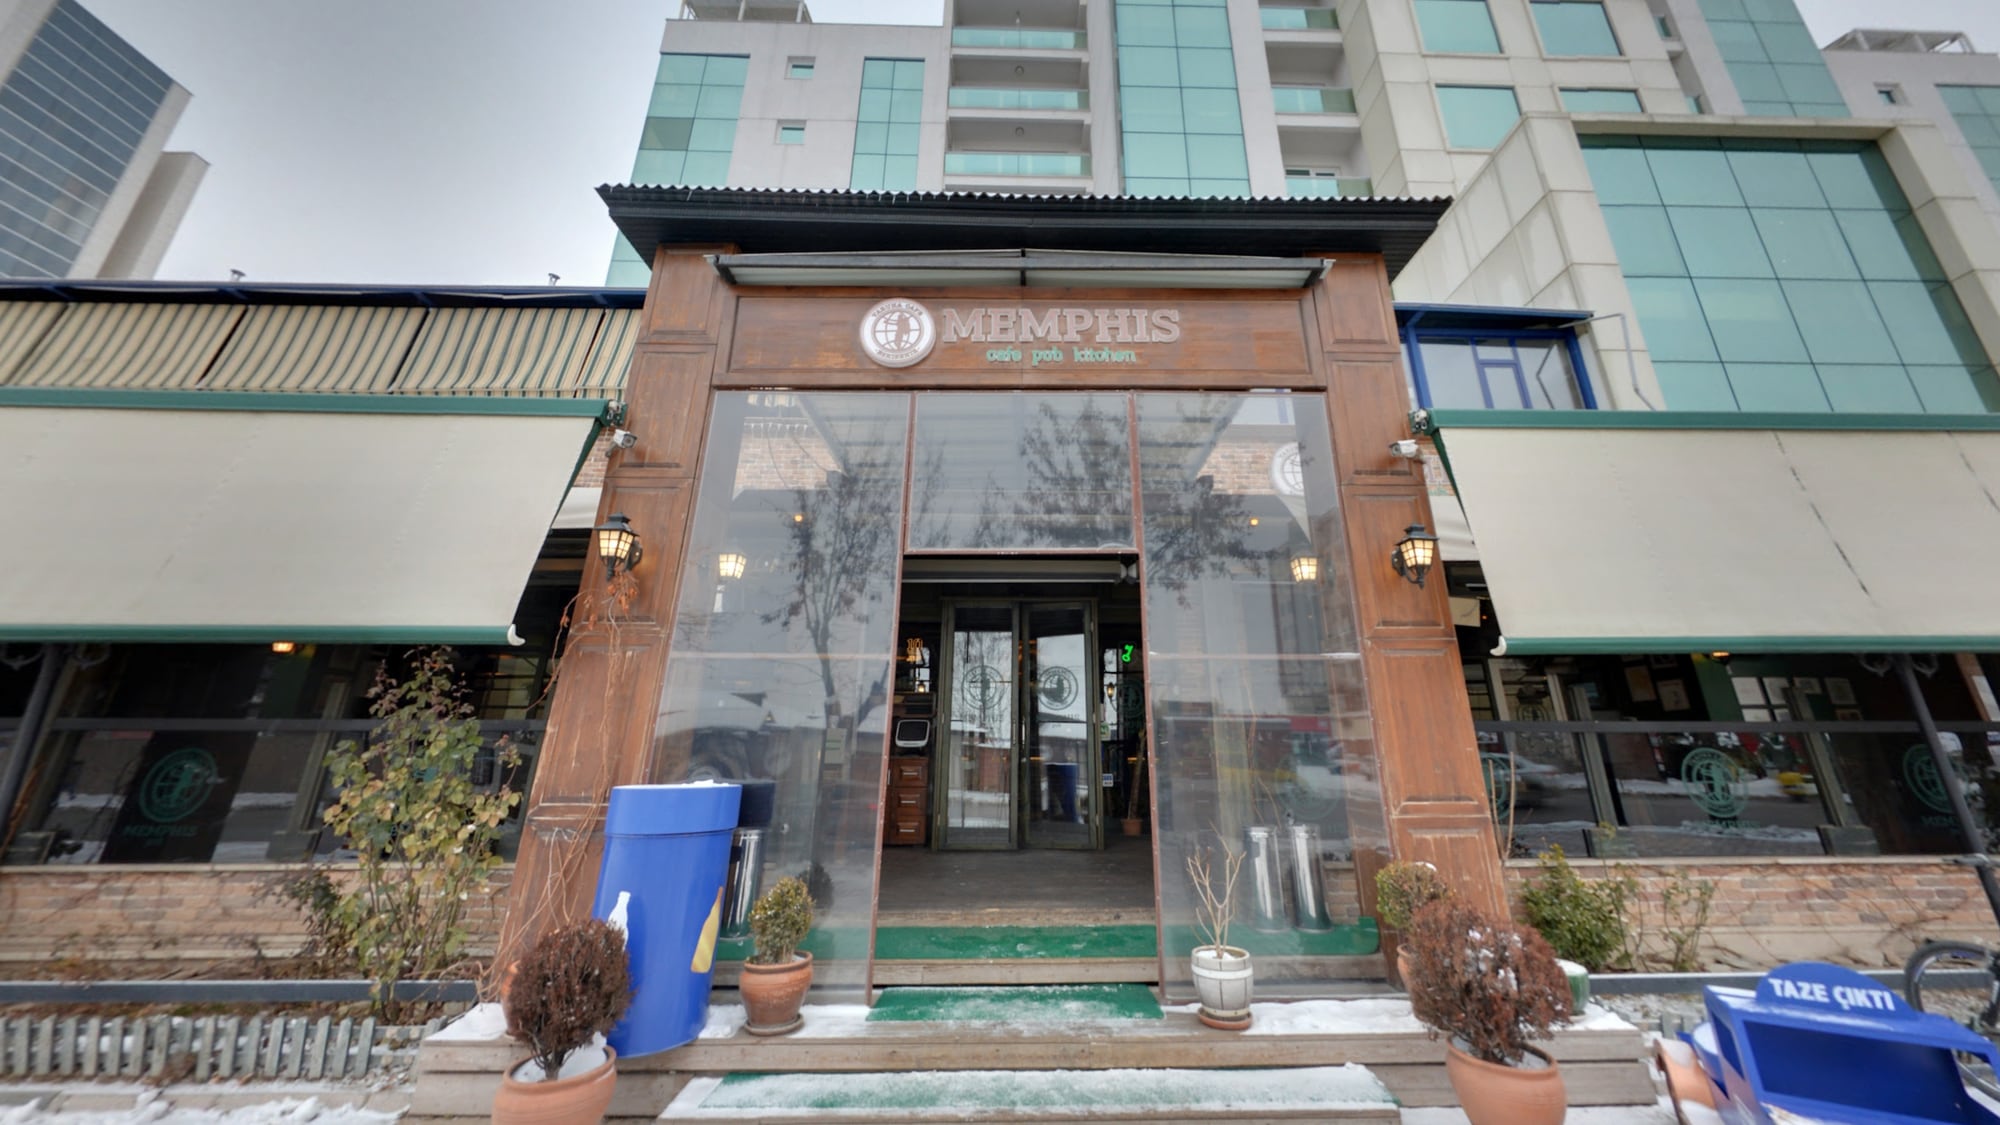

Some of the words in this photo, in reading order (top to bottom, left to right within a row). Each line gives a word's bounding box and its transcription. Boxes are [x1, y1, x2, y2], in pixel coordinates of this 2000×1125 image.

[942, 307, 1181, 343] MEMPHIS
[986, 346, 1022, 362] cafe
[1768, 978, 1830, 1003] TAZE
[1832, 985, 1896, 1011] ÇIKTI
